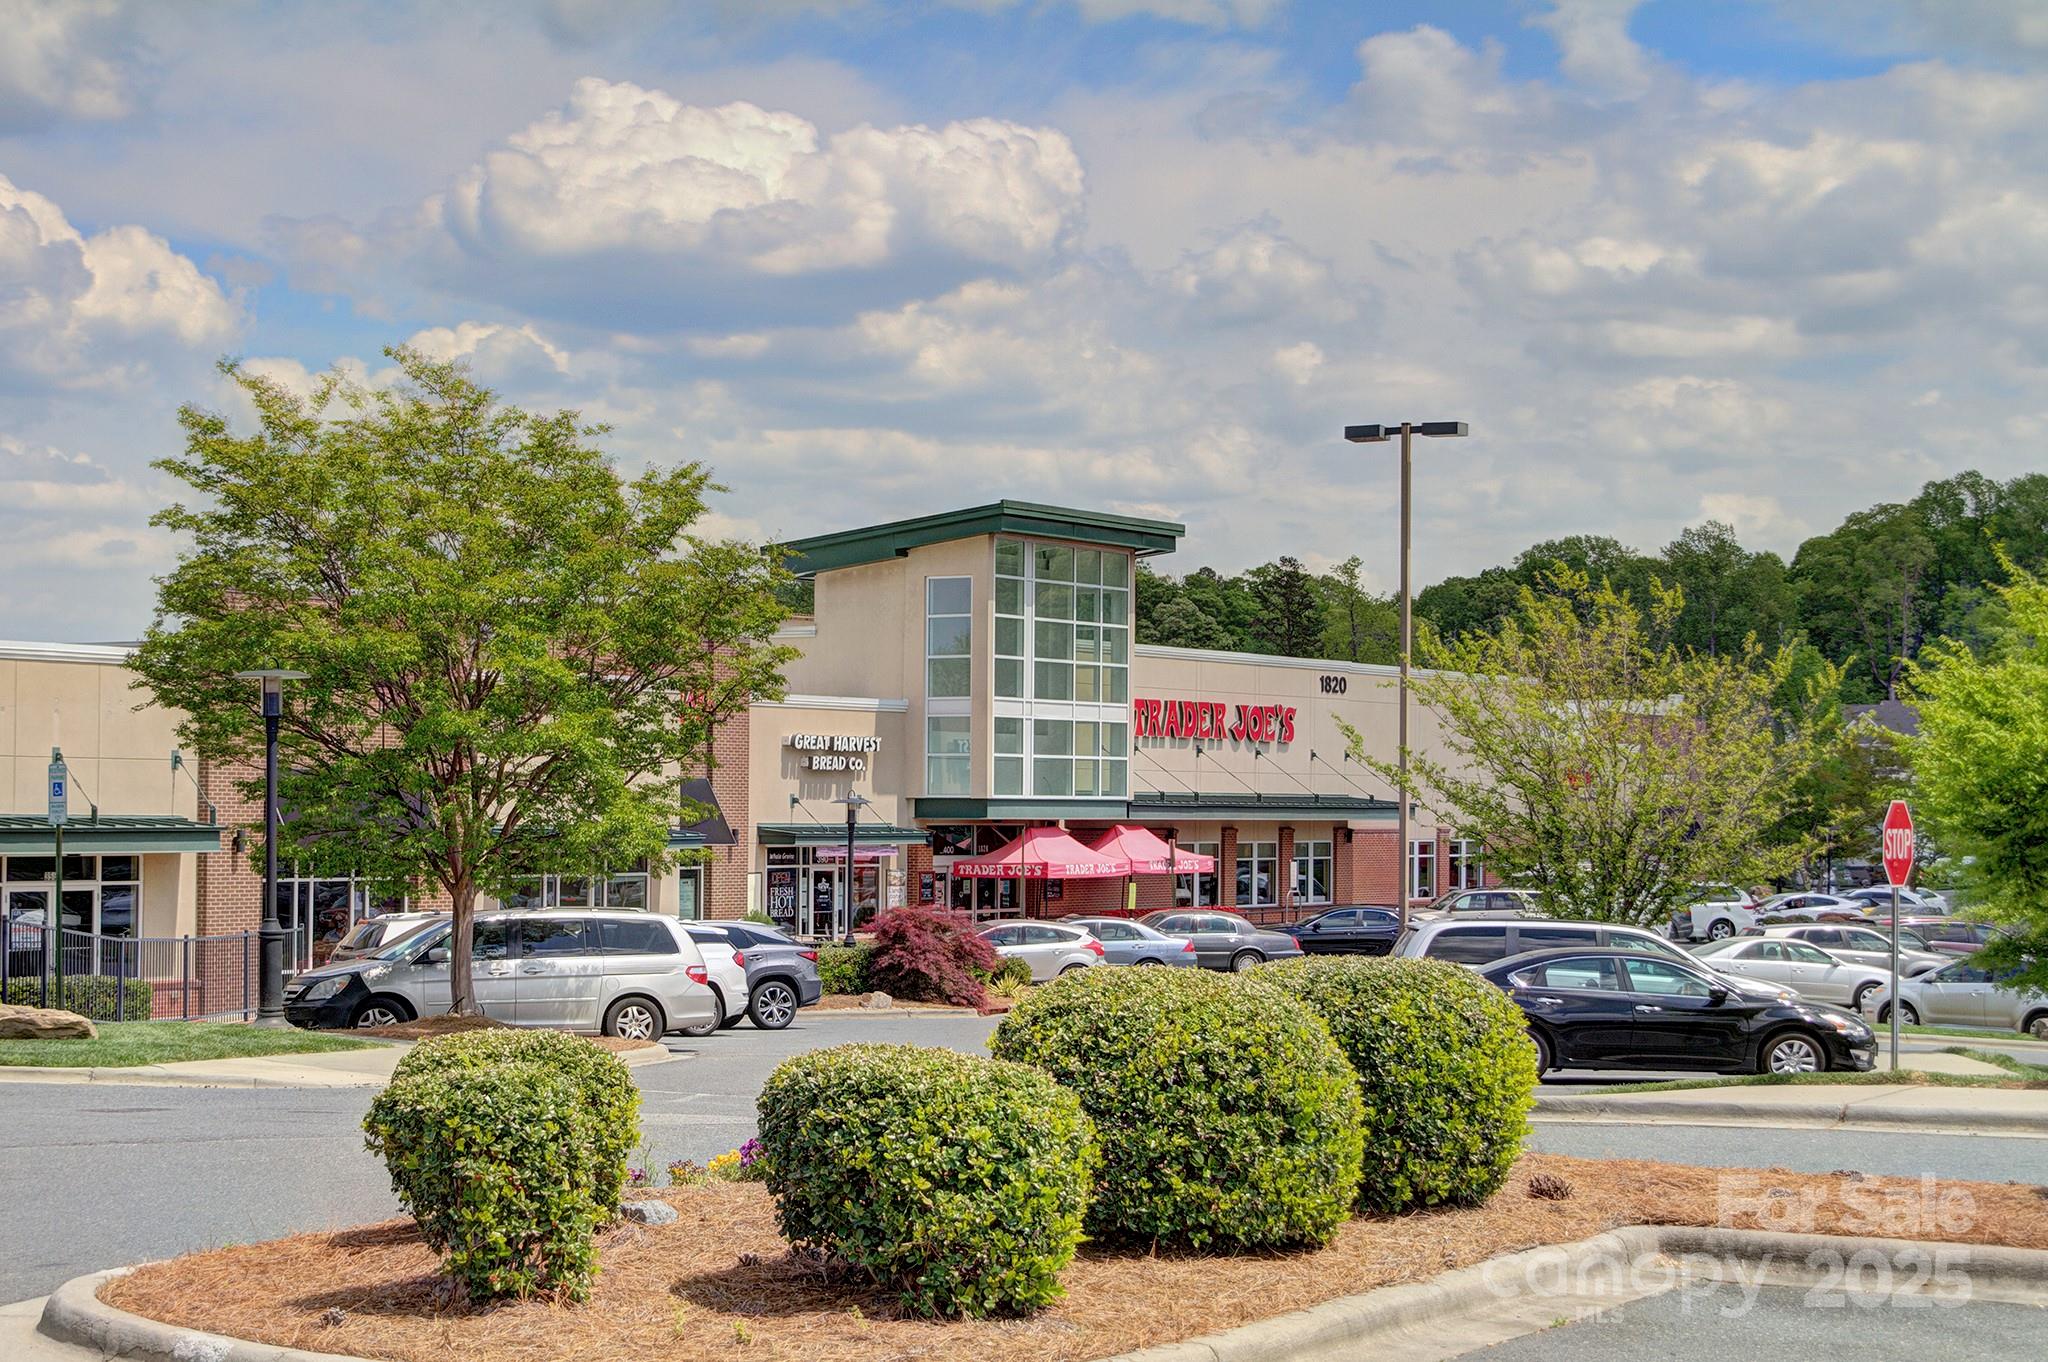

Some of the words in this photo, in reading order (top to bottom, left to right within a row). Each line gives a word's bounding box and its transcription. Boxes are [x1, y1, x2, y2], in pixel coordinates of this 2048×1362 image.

[1319, 675, 1347, 694] 1820
[1134, 698, 1228, 739] TRADER
[1229, 704, 1297, 743] JOE'S
[794, 734, 830, 751] GREAT
[833, 735, 882, 752] HARVEST
[812, 756, 846, 771] BREAD
[943, 846, 954, 854] 400
[1885, 828, 1911, 860] STOP
[958, 864, 1004, 876] TRADER
[1007, 865, 1043, 876] JOE'S
[1065, 863, 1095, 875] TRADER
[1096, 863, 1117, 874] JOE'S
[1178, 859, 1199, 870] JOE'S
[770, 887, 794, 896] FRESH
[770, 895, 794, 909] HOT
[770, 908, 794, 918] BREAD
